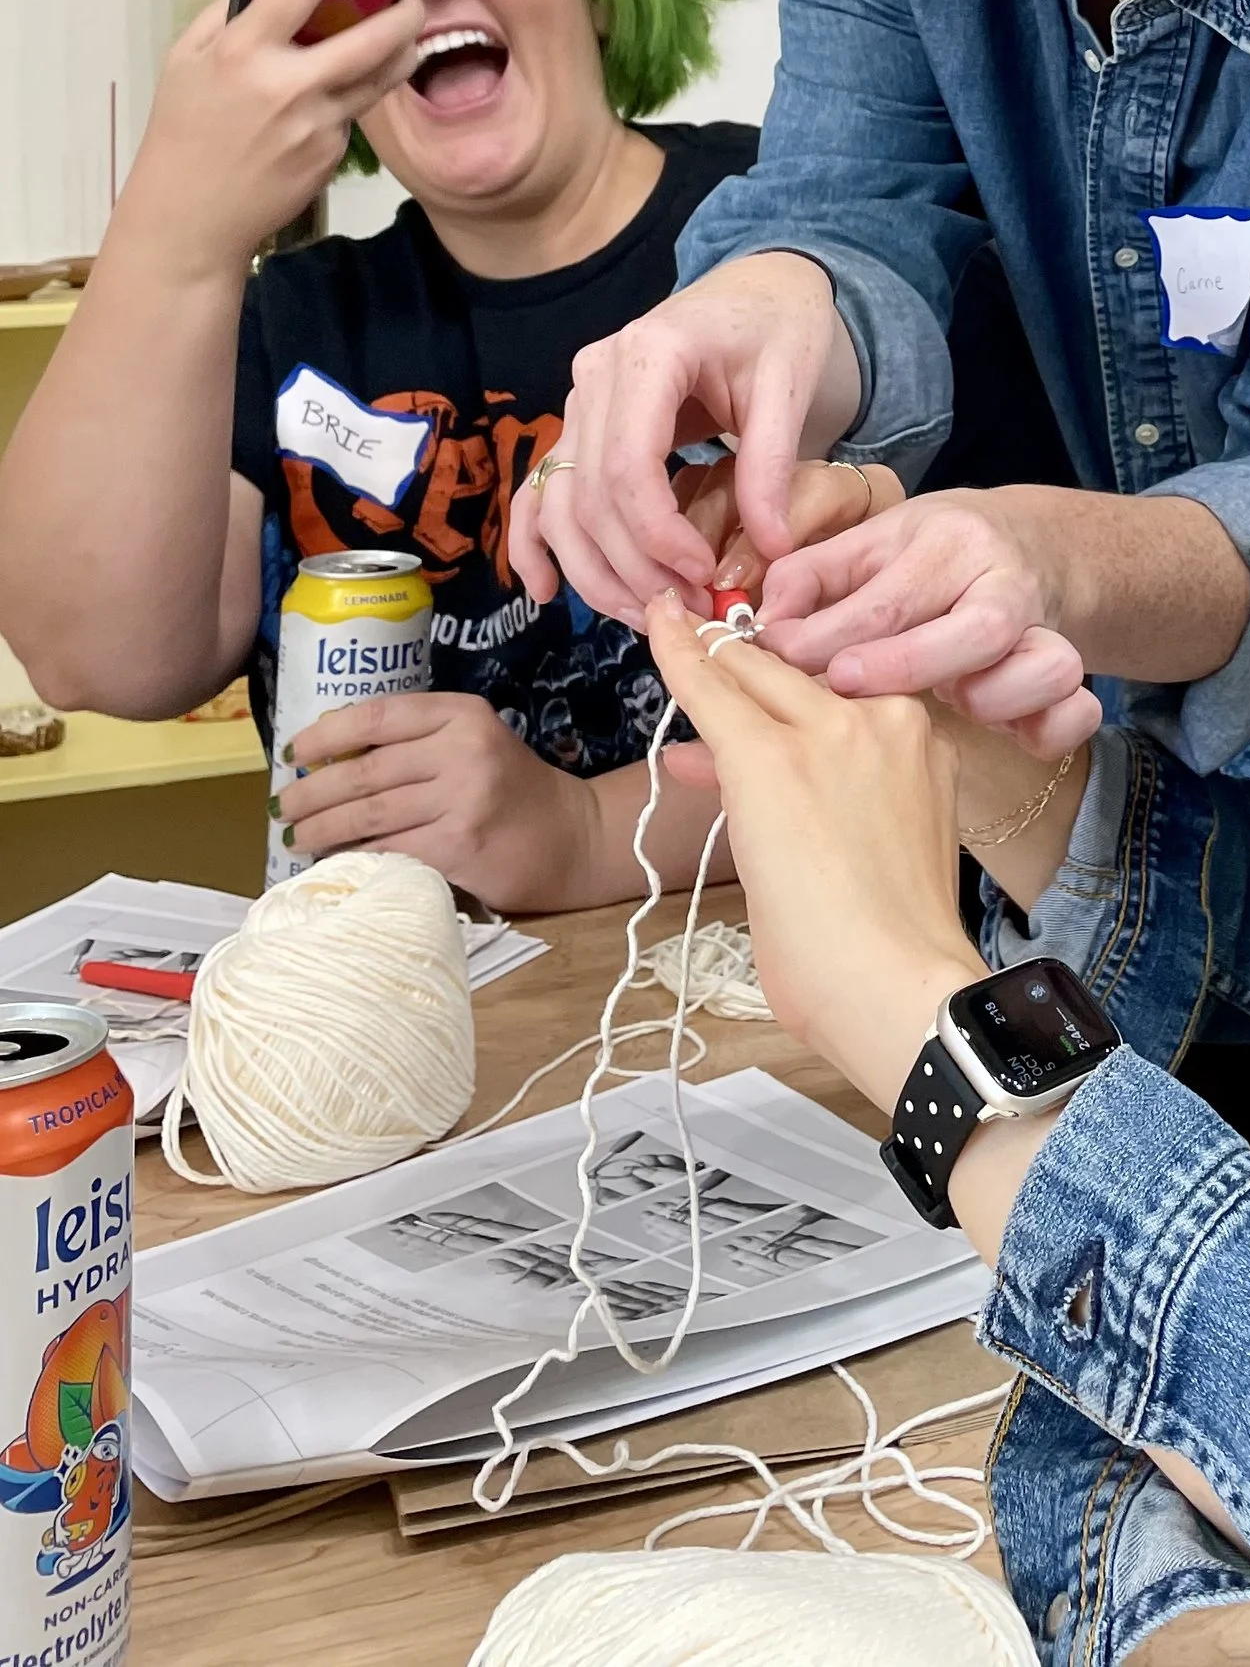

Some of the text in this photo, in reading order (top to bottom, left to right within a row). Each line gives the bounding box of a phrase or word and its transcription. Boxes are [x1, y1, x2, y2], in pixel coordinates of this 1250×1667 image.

[301, 399, 382, 460] BRIE
[344, 591, 409, 606] LEMONADE
[317, 638, 424, 675] leisure
[316, 674, 422, 696] HYDRATION
[984, 1001, 1007, 1025] 2:18
[1007, 1056, 1033, 1084] SUN
[1020, 1053, 1044, 1078] OCT
[1045, 1061, 1056, 1072] 5
[28, 1085, 119, 1134] TROPICAL
